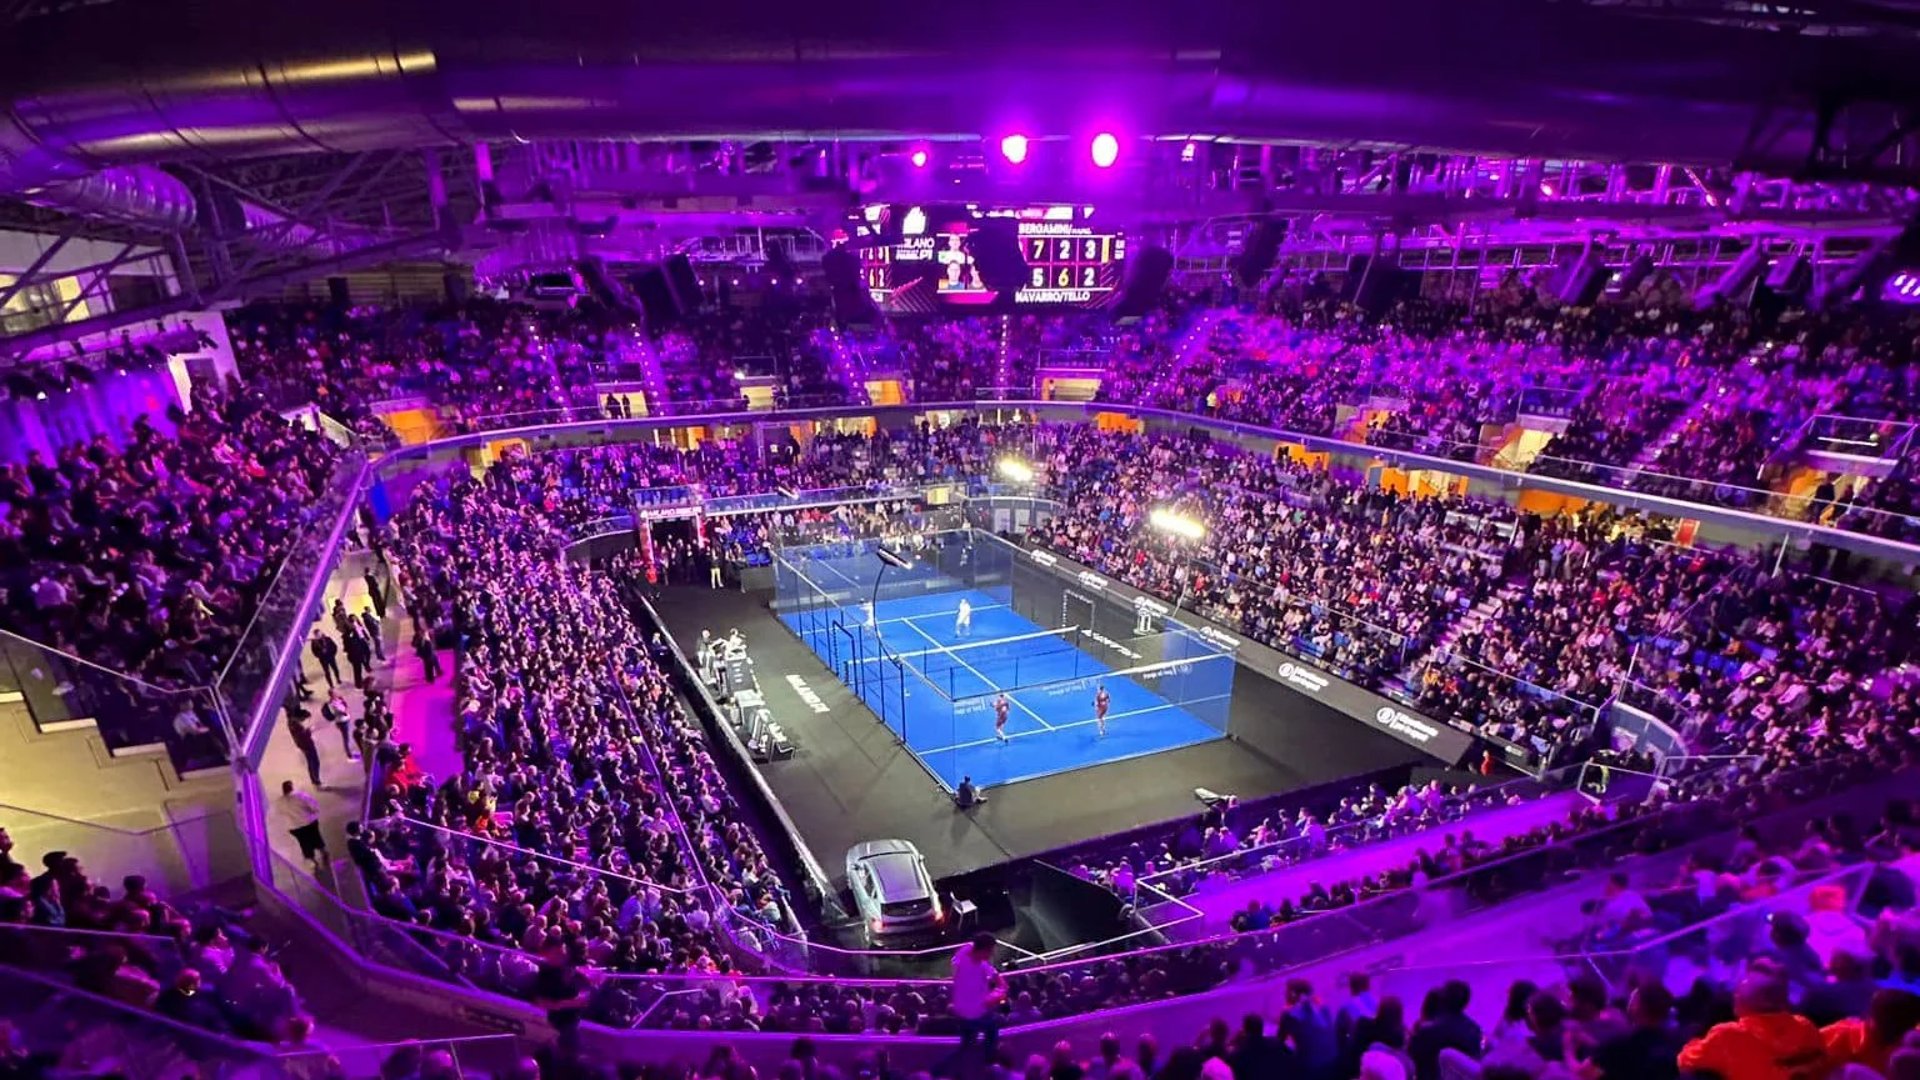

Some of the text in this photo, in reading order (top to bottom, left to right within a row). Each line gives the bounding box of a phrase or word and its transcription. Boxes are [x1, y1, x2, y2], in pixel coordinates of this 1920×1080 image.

[1033, 239, 1045, 259] 7
[1059, 239, 1071, 259] 2
[1085, 239, 1096, 259] 3
[1032, 267, 1095, 287] 5 6 2
